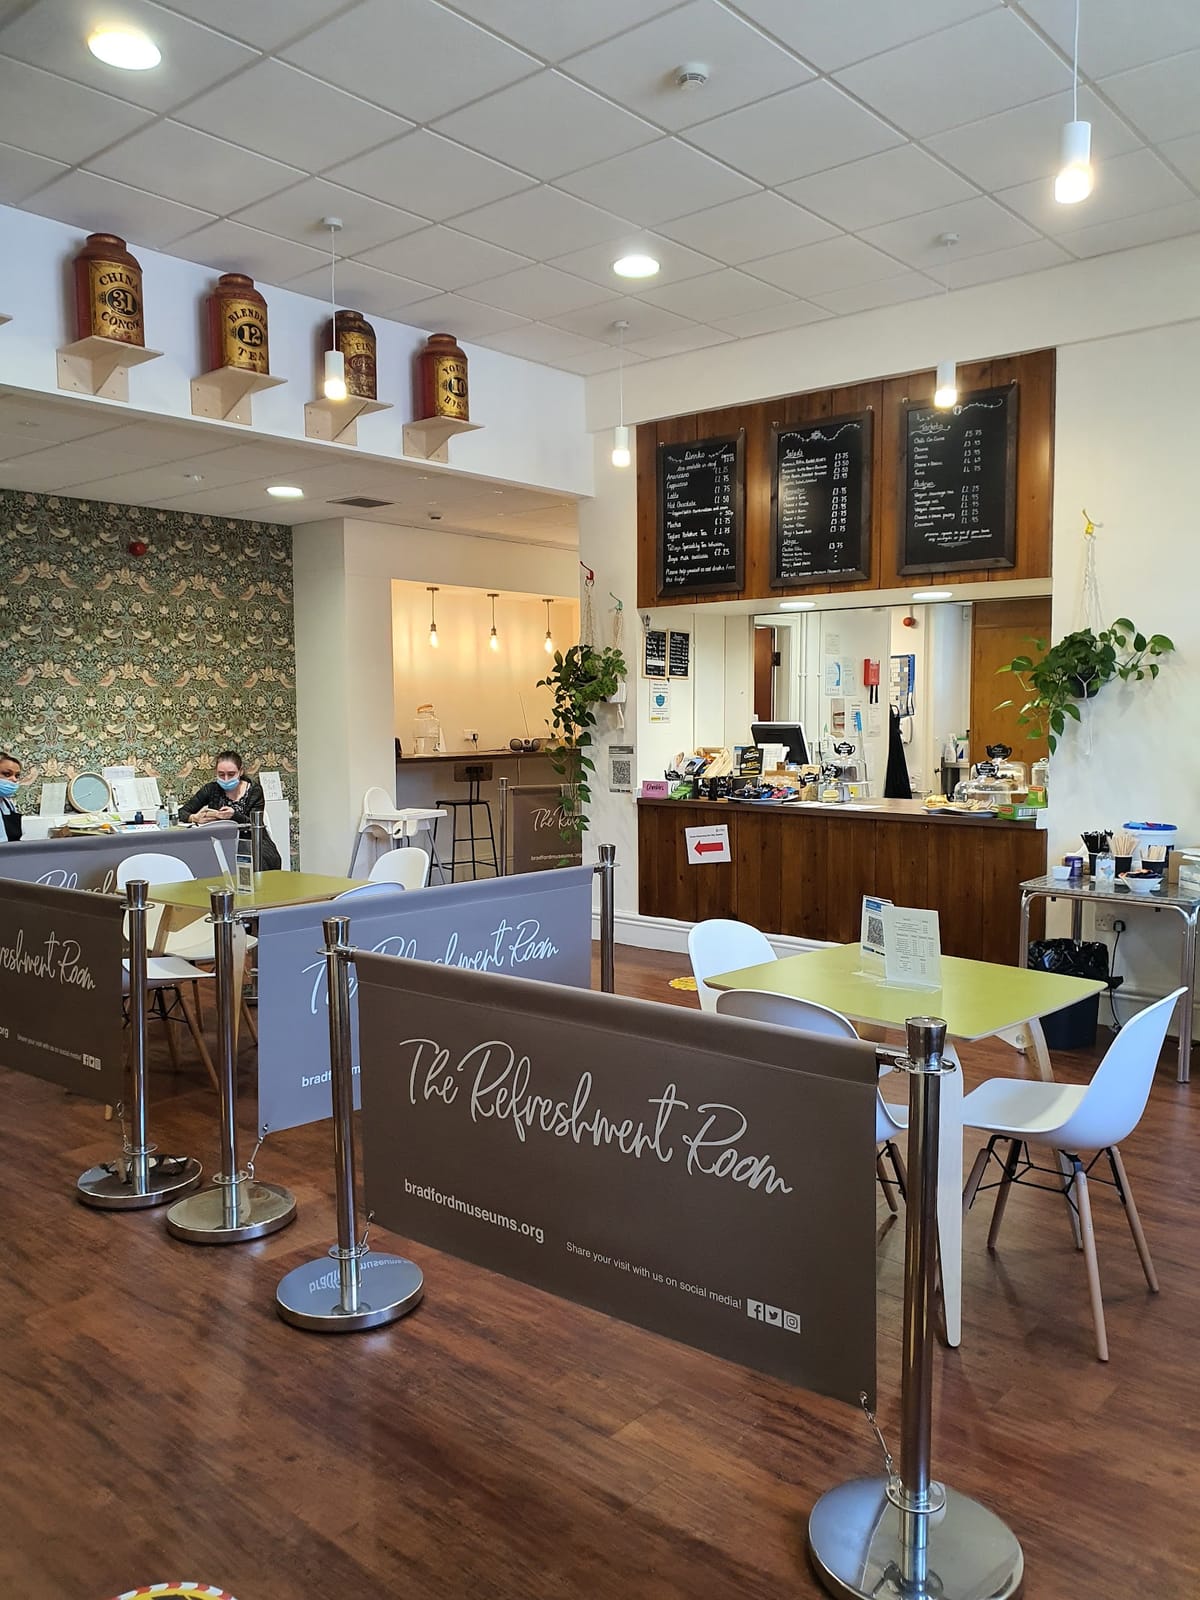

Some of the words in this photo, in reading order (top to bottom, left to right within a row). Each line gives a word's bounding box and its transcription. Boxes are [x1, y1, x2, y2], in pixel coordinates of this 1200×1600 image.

[112, 290, 134, 313] 31
[238, 346, 266, 361] TEA
[242, 325, 262, 345] 12
[531, 808, 554, 831] The
[57, 940, 97, 990] Room
[509, 919, 559, 967] Room
[399, 1038, 459, 1105] The
[457, 1040, 689, 1163] Refreshment
[683, 1103, 793, 1195] Room
[404, 1179, 545, 1246] bradfordmuseums.org
[566, 1241, 591, 1259] Share
[592, 1248, 612, 1267] your
[613, 1255, 631, 1273] visit
[632, 1261, 650, 1279] with
[652, 1271, 664, 1284] us
[665, 1275, 678, 1288] on
[679, 1277, 707, 1299] social
[709, 1285, 742, 1310] media!
